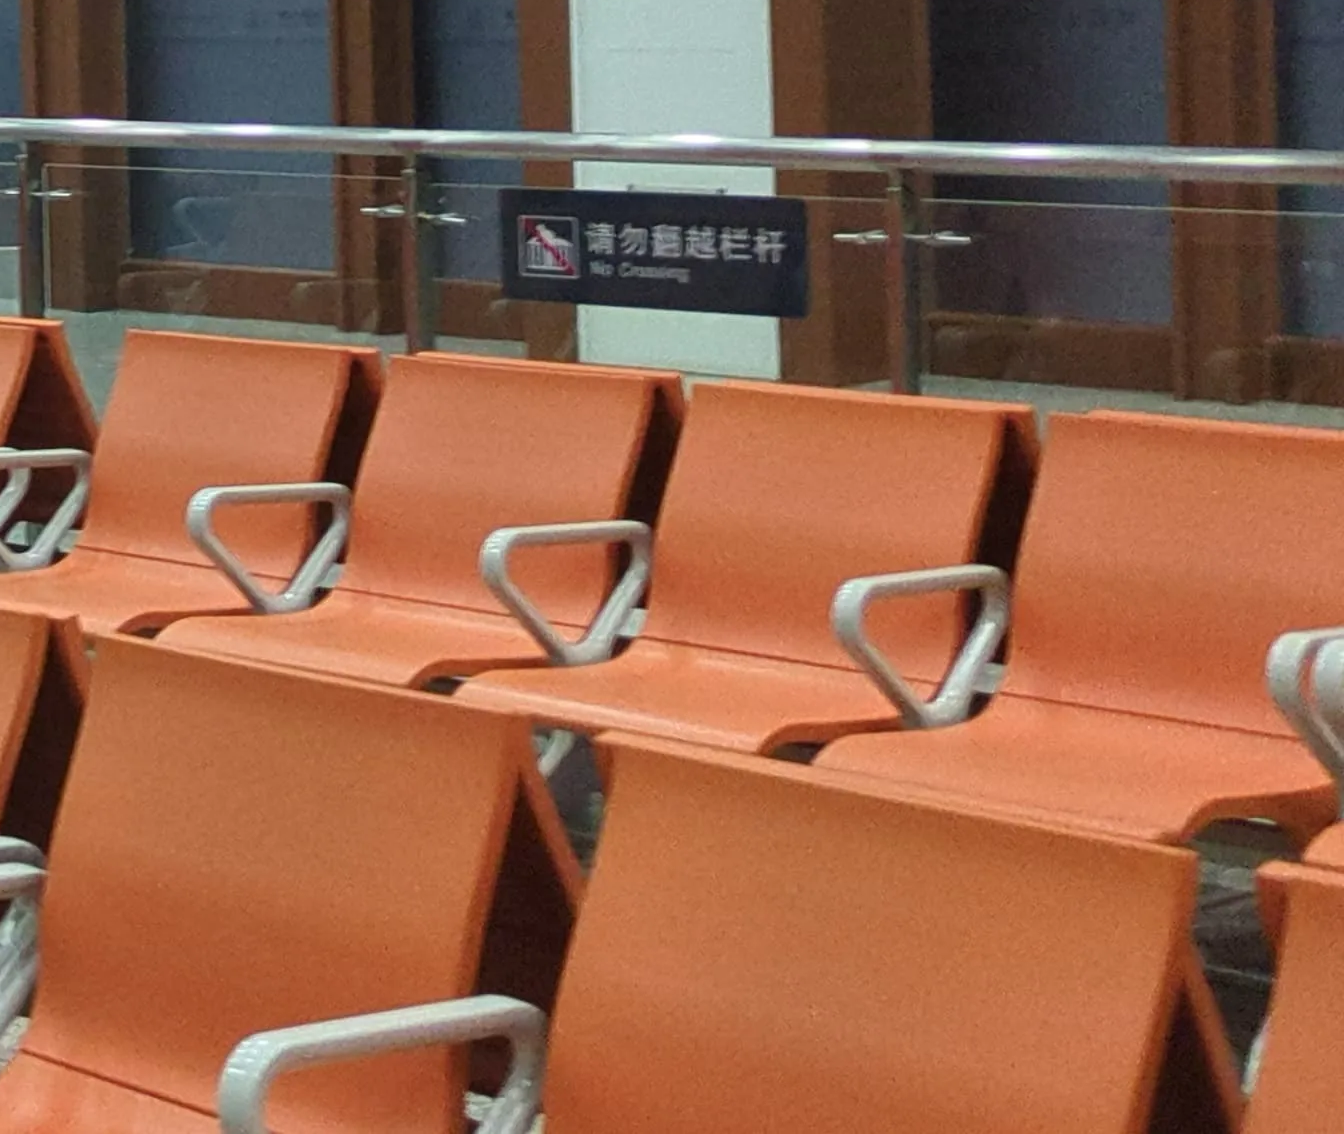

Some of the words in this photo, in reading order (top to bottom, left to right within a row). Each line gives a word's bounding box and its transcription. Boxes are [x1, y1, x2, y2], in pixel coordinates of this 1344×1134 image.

[584, 221, 787, 264] 请勿翻越栏杆
